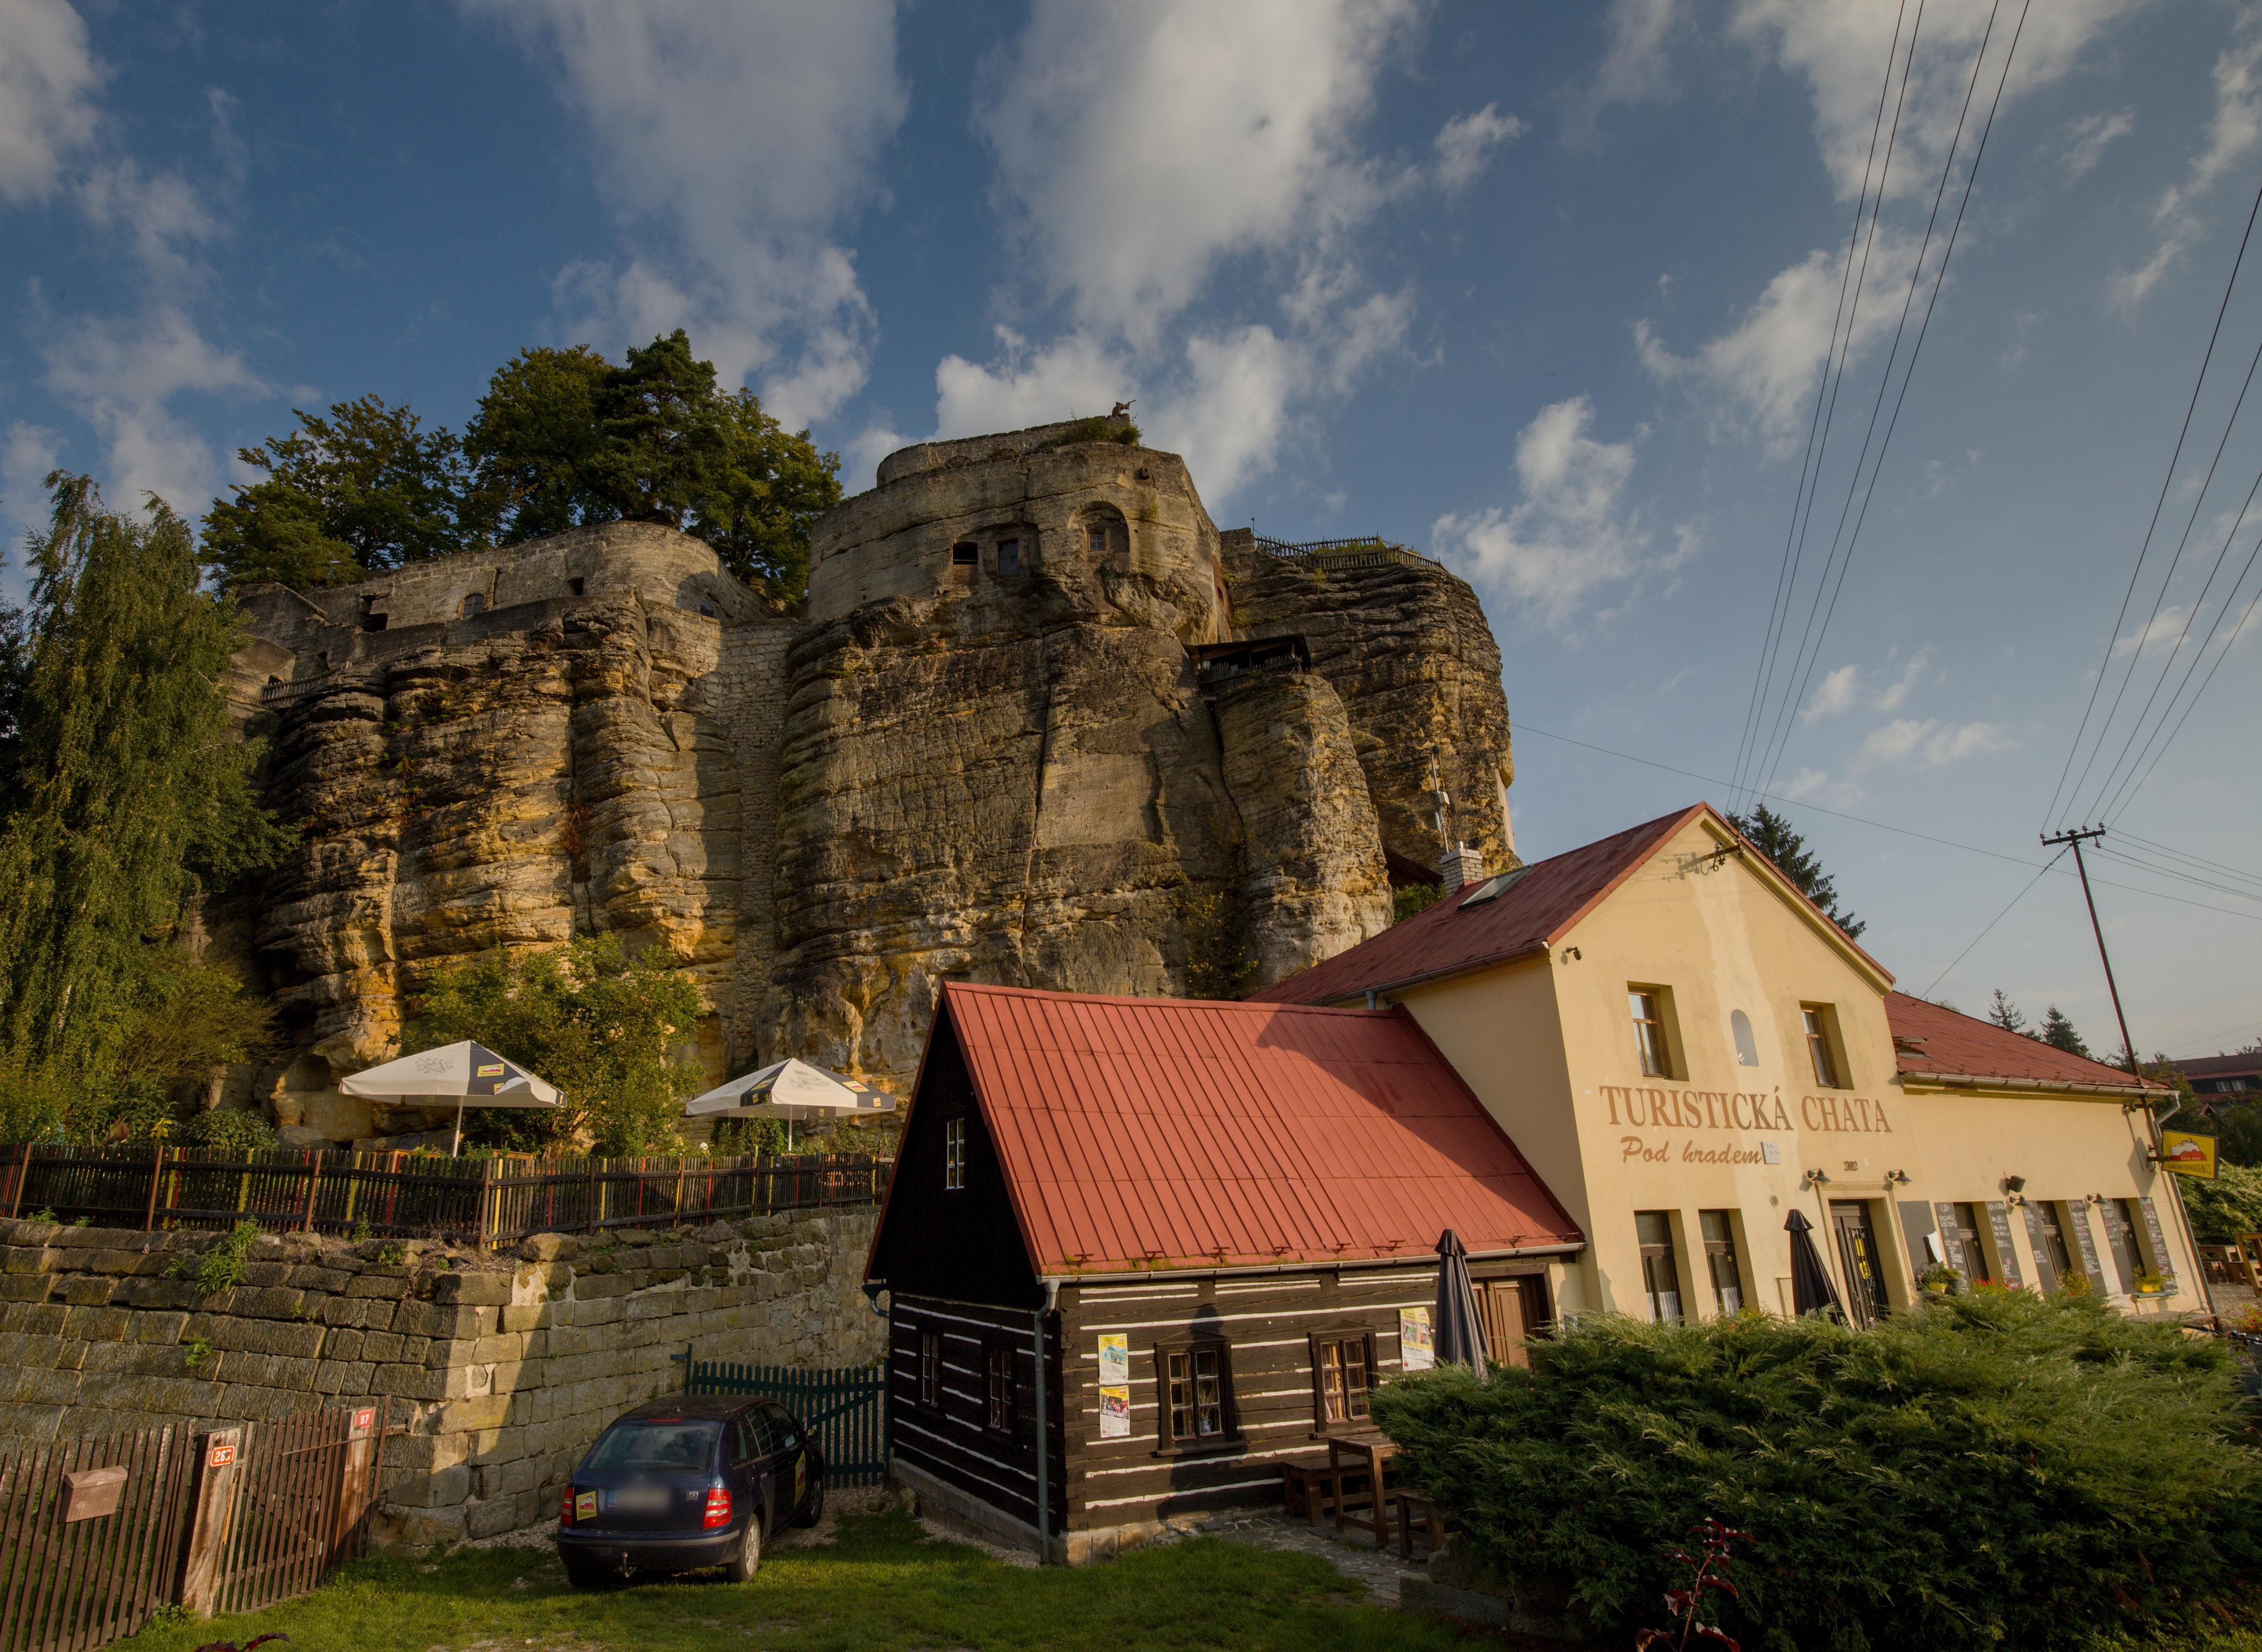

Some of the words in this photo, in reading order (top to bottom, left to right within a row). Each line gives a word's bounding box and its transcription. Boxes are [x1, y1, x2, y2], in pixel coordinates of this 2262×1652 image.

[1599, 1085, 1794, 1131] TURISTICKÁ
[1801, 1095, 1893, 1132] CHATA
[1620, 1136, 1670, 1164] Pod
[1682, 1139, 1762, 1165] hradem
[360, 1413, 370, 1425] 97
